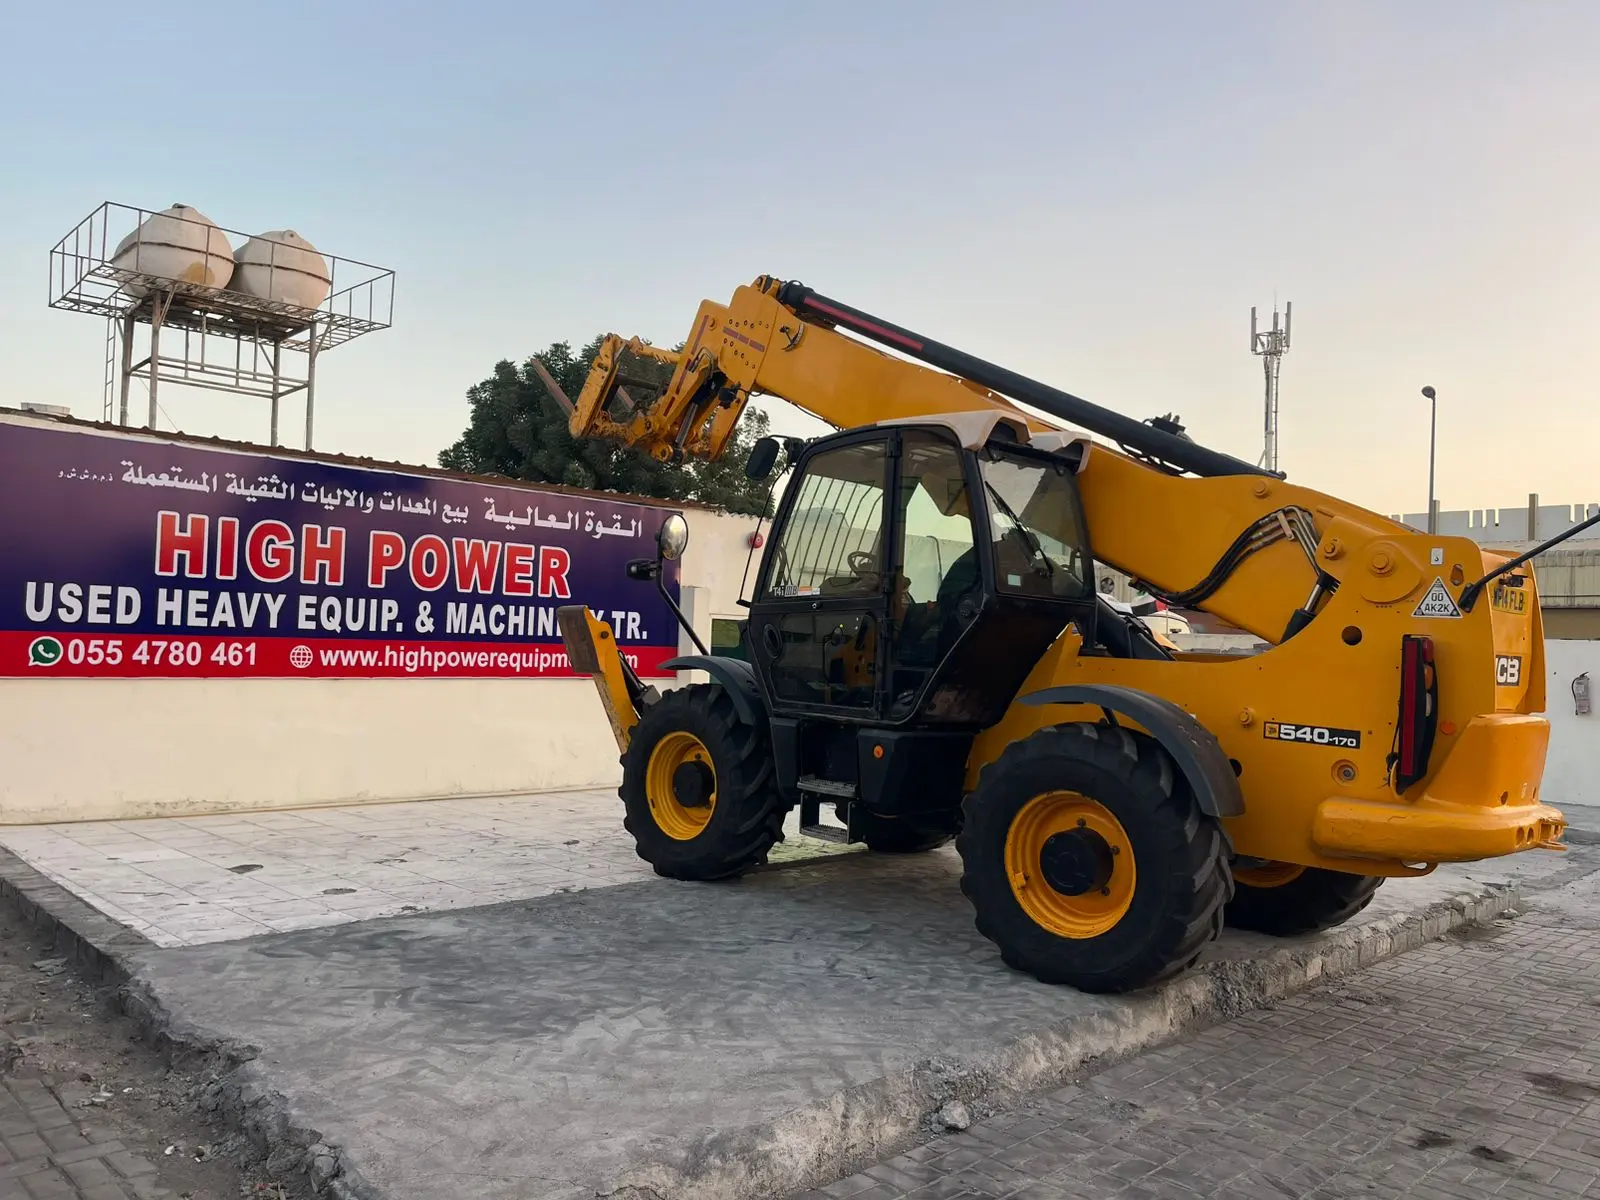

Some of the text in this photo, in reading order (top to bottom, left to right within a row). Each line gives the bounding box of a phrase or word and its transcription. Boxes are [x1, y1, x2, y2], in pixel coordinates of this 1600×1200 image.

[120, 459, 218, 493] المستعملة
[224, 472, 295, 503] الثقيلة
[379, 491, 437, 516] المعدات
[441, 503, 469, 524] بيع
[483, 496, 580, 531] العالية
[584, 510, 643, 539] القوة
[155, 510, 572, 599] HIGH POWER
[25, 581, 648, 640] USED HEAVY EQUIP. & MACHIN TR.
[1424, 603, 1450, 613] AK2K
[67, 638, 257, 667] 055 4780 461
[320, 645, 638, 673] www.highpowerequipmm
[1496, 657, 1520, 683] CB
[1280, 724, 1357, 747] 540-170
